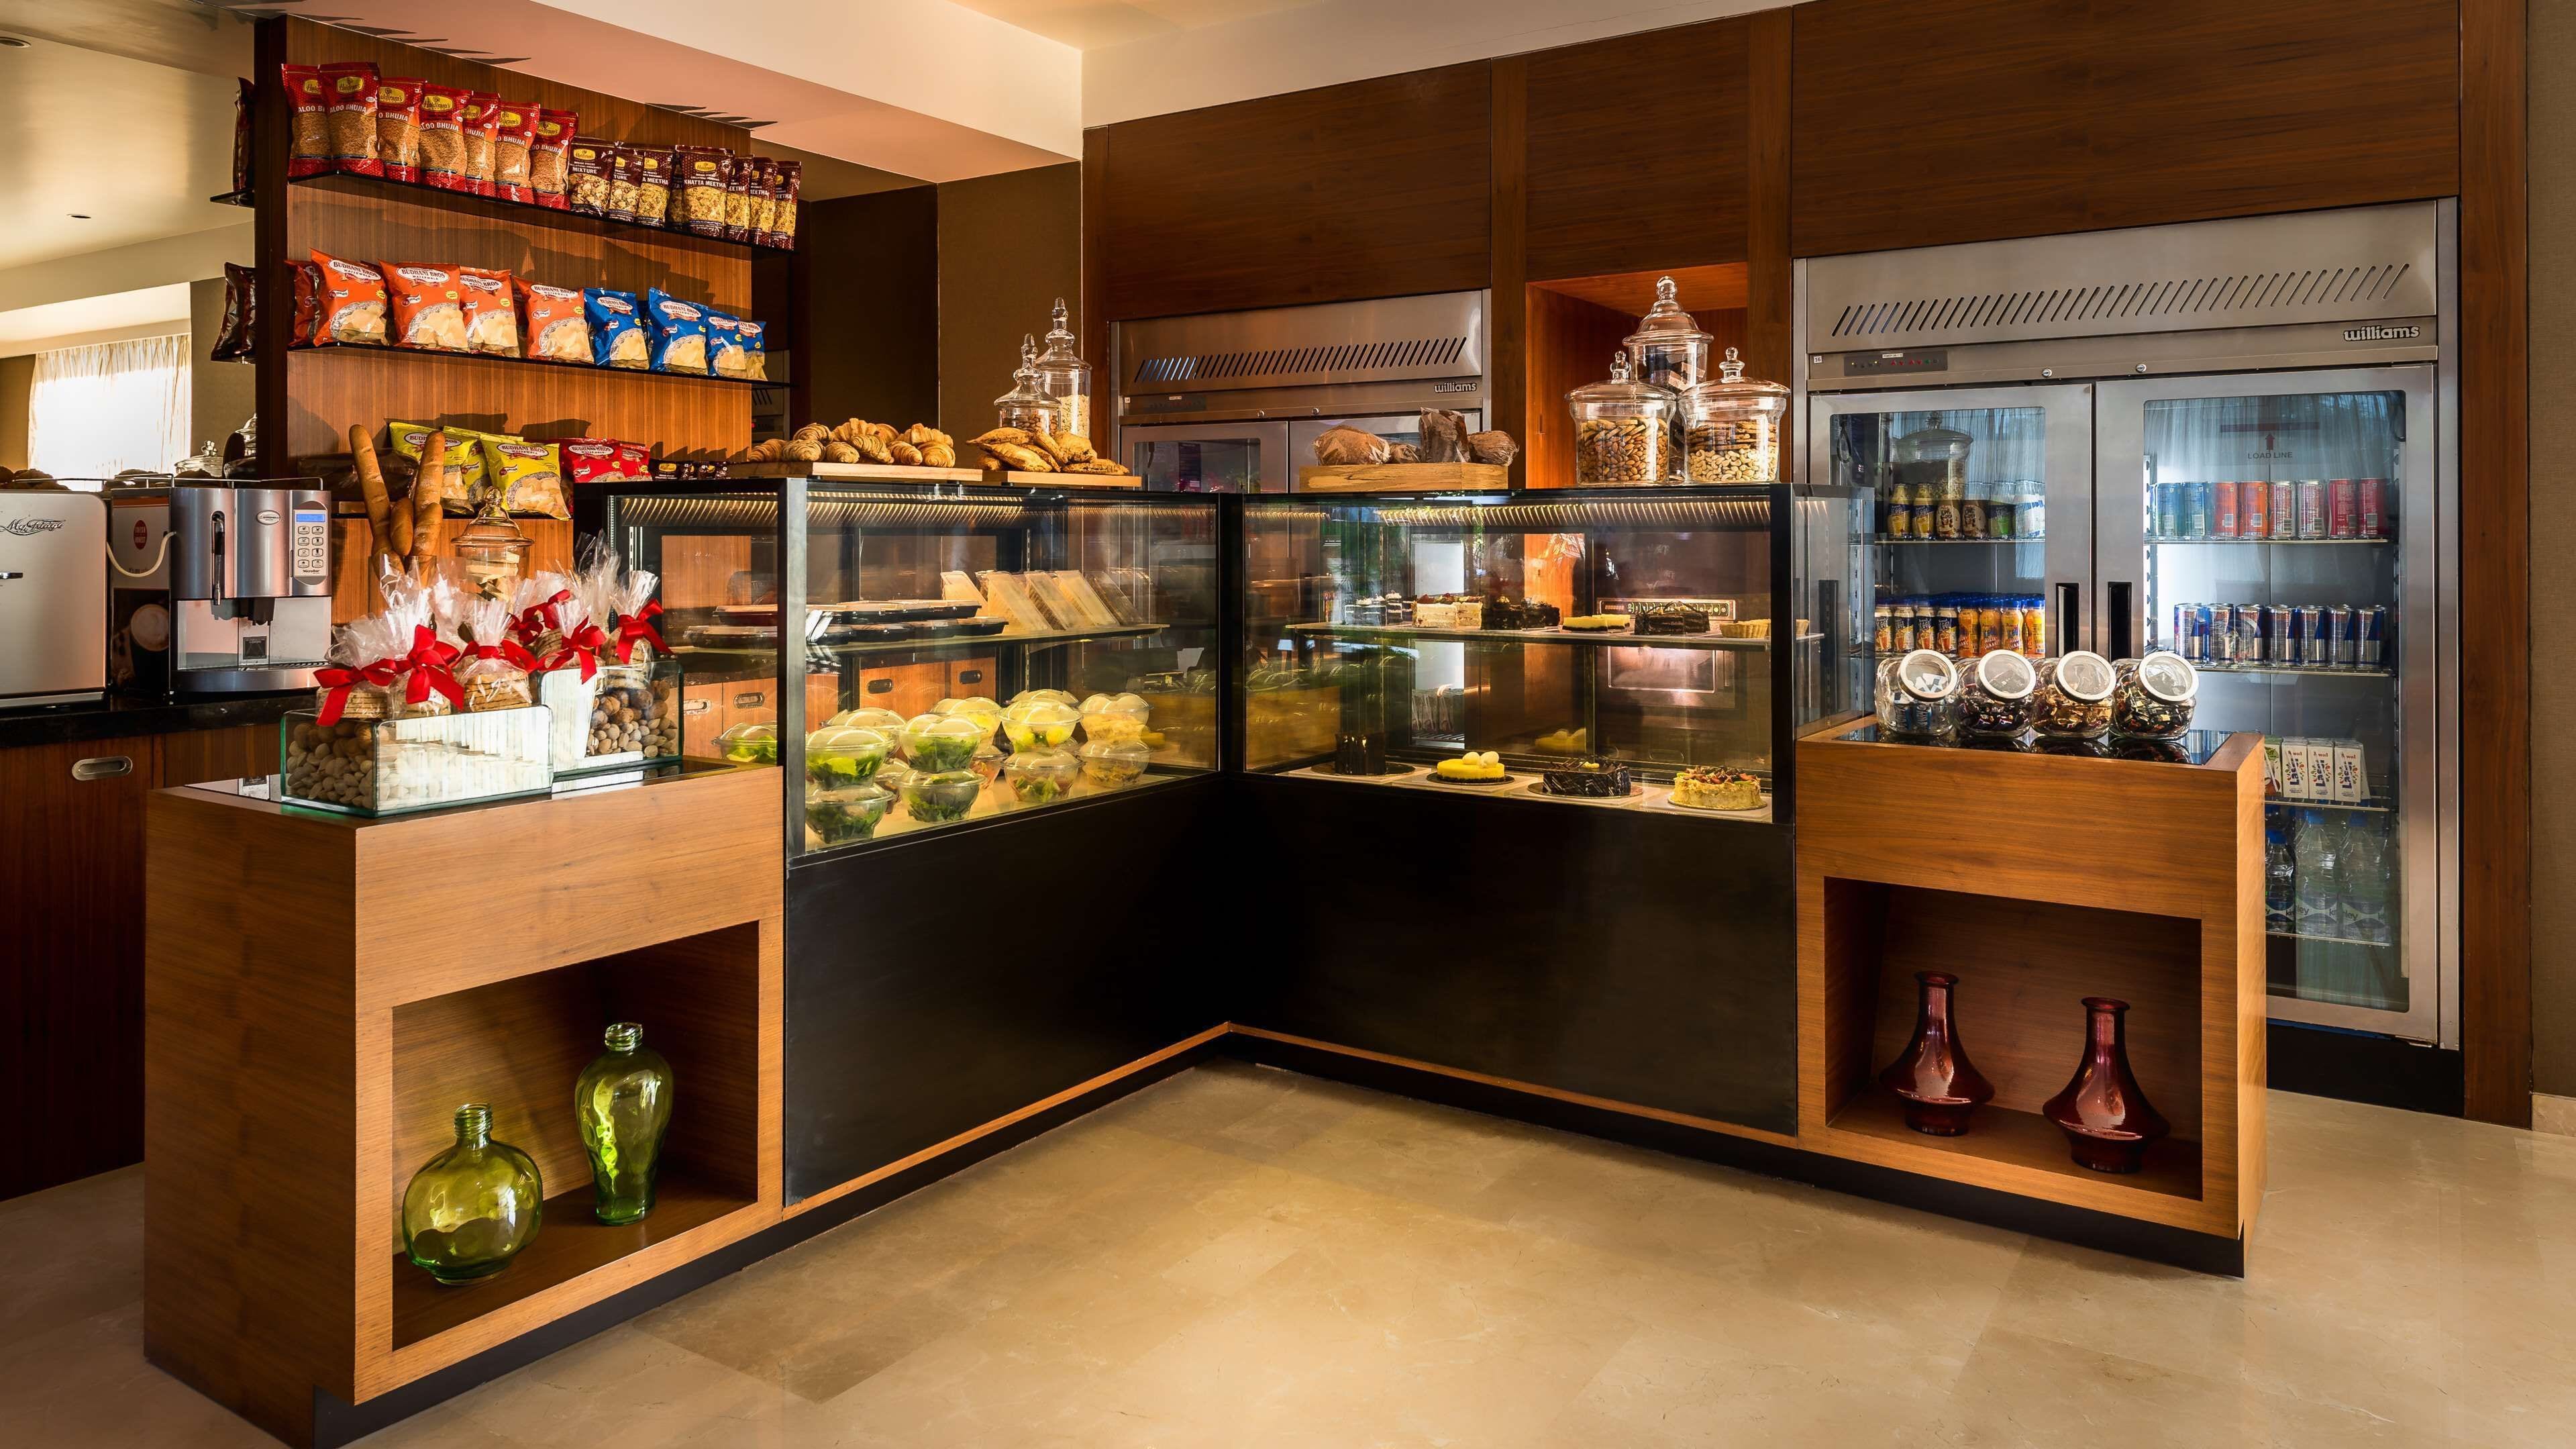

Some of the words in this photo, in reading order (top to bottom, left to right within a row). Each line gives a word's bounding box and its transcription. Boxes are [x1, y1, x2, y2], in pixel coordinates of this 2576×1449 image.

[329, 105, 344, 113] ALOO
[346, 104, 367, 113] BHUJIA
[386, 113, 409, 121] BHUJIA
[419, 122, 435, 131] ALOO
[437, 122, 459, 132] BHUJIA
[503, 136, 527, 146] BHUJIA
[541, 144, 562, 154] BHUJIA
[572, 166, 598, 174] MIXTURE
[648, 177, 668, 185] MEETHA
[705, 180, 727, 188] MEETHA
[333, 261, 362, 272] BUDHANI
[362, 268, 379, 279] BROS
[401, 268, 429, 277] BUDHANI
[430, 271, 446, 279] BROS
[534, 286, 560, 294] BUDHANI
[663, 304, 686, 312] BUDHANI
[2343, 326, 2420, 341] williams
[1435, 382, 1477, 393] williams
[530, 446, 545, 454] BROS
